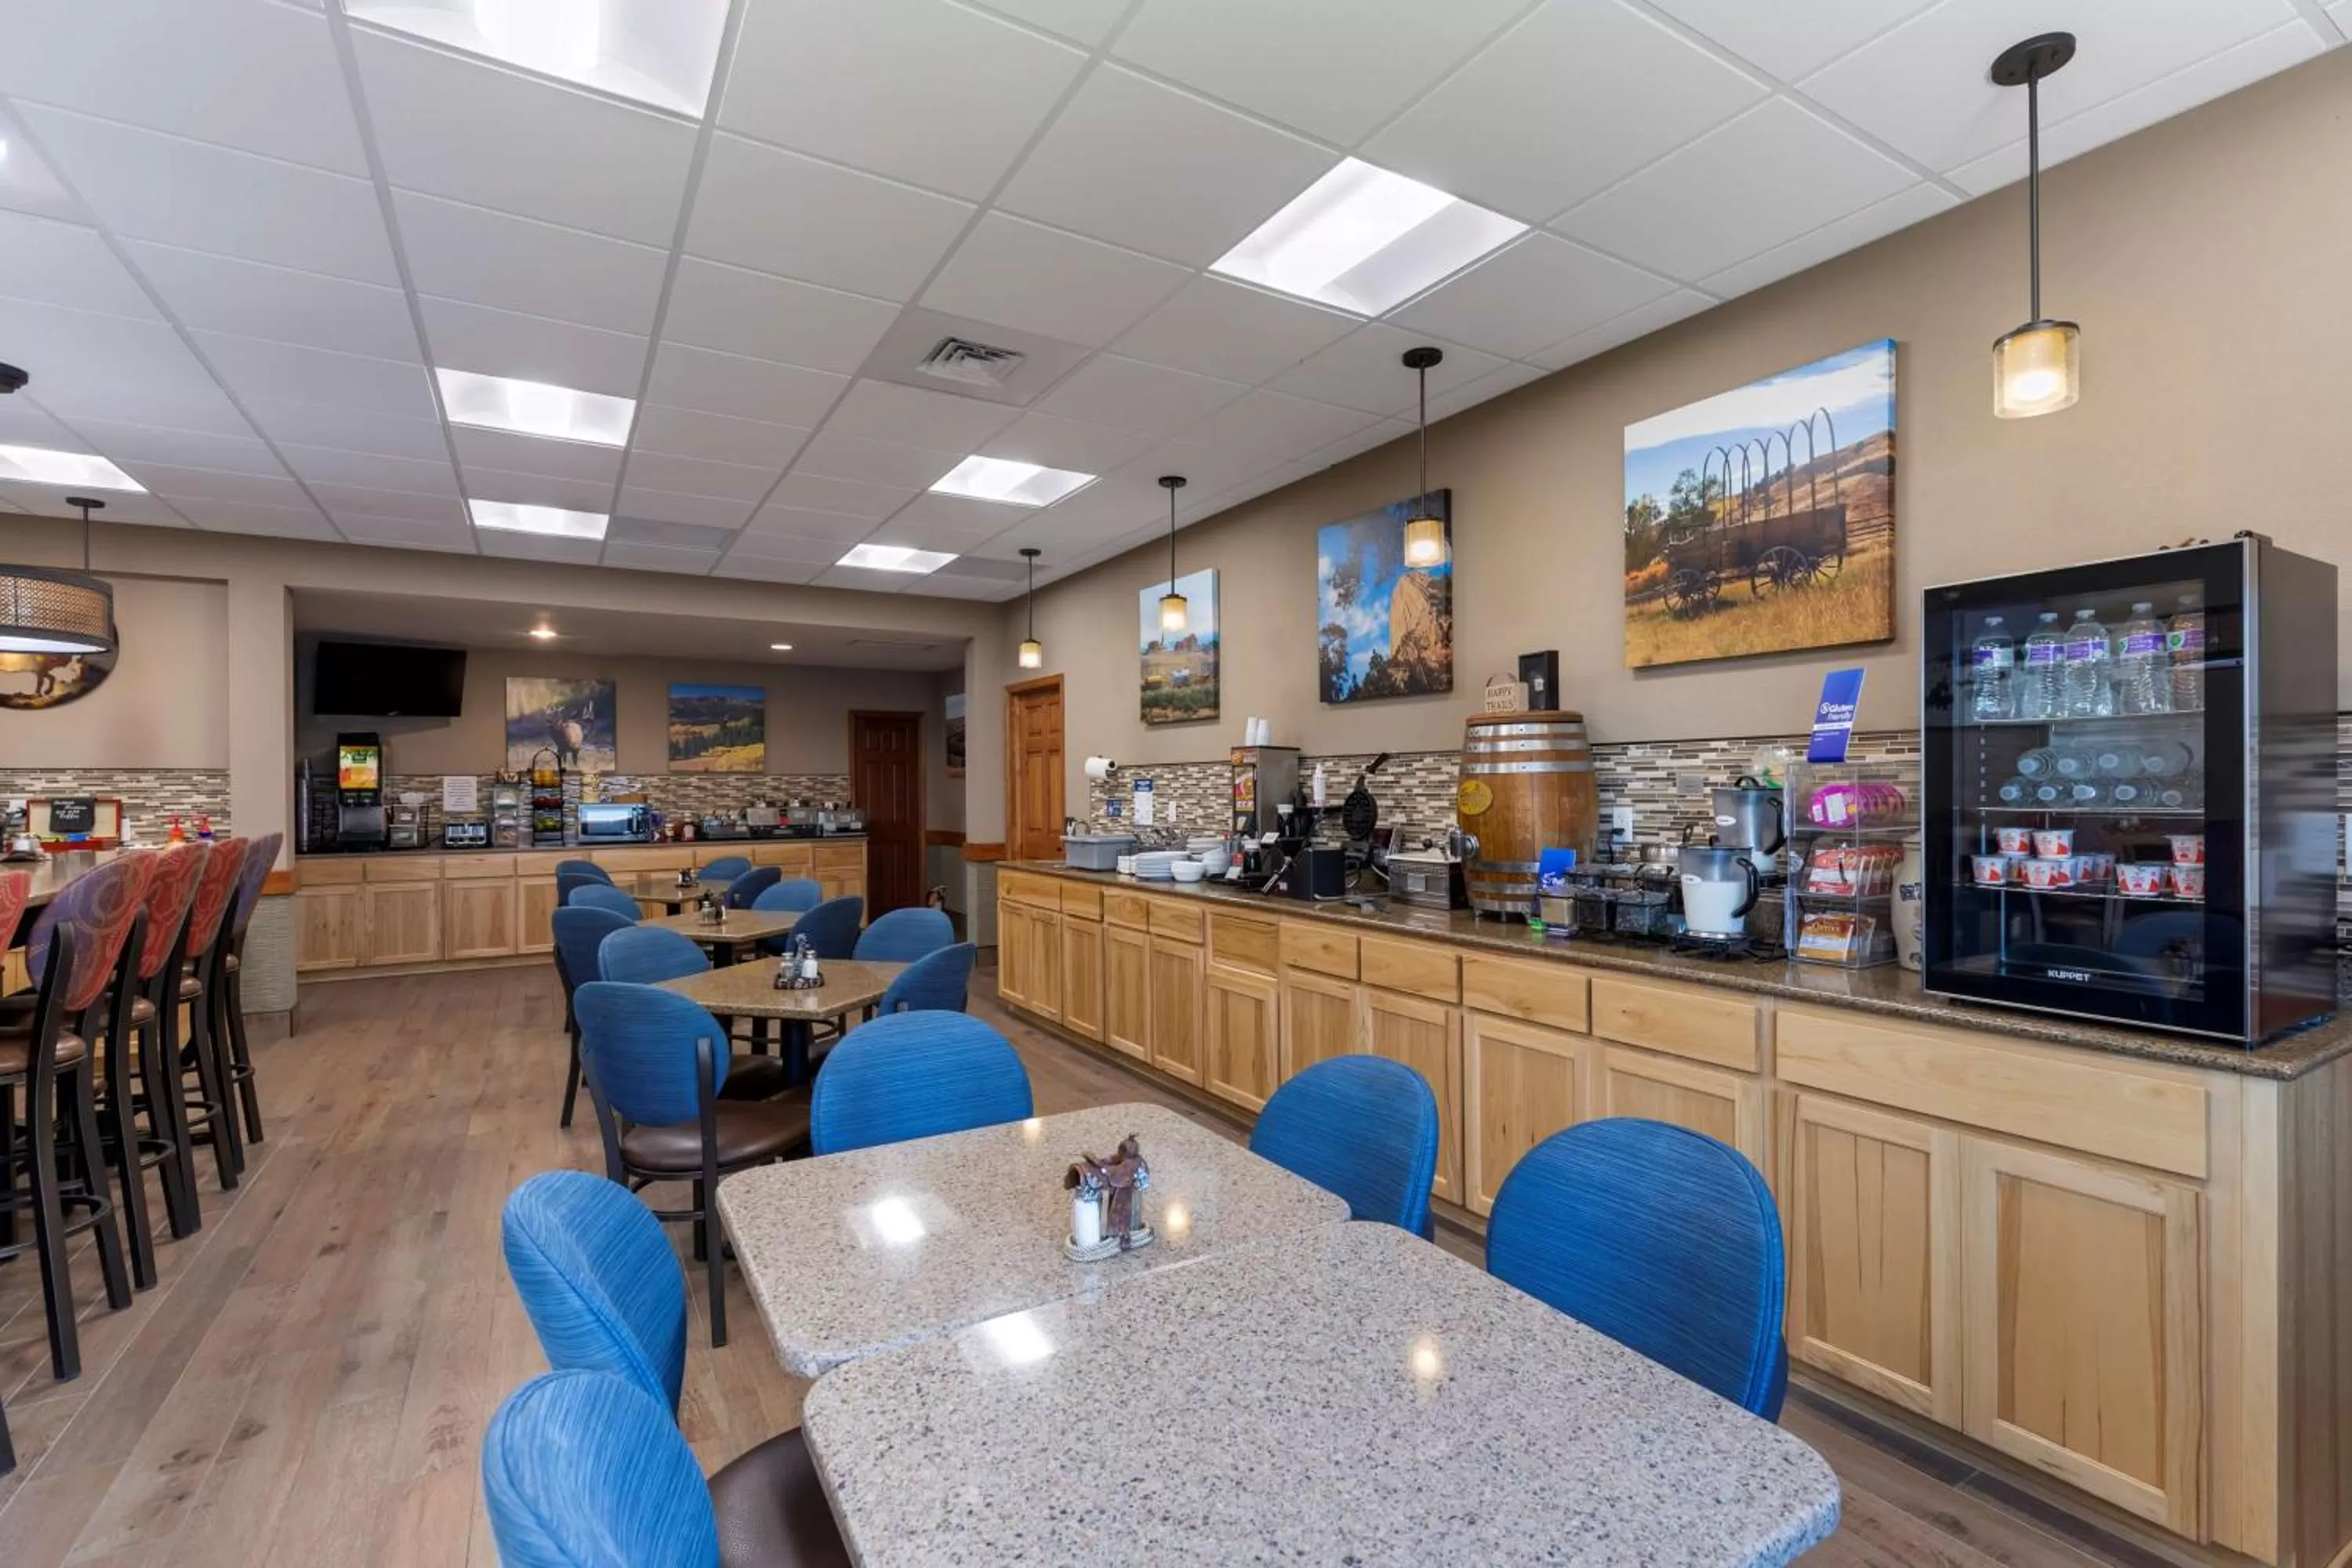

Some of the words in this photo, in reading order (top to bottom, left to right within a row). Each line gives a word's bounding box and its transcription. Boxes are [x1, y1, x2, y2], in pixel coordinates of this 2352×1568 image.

[1487, 687, 1512, 697] HAPPY
[1829, 704, 1854, 713] Gluten
[2047, 969, 2090, 982] KUPPET
